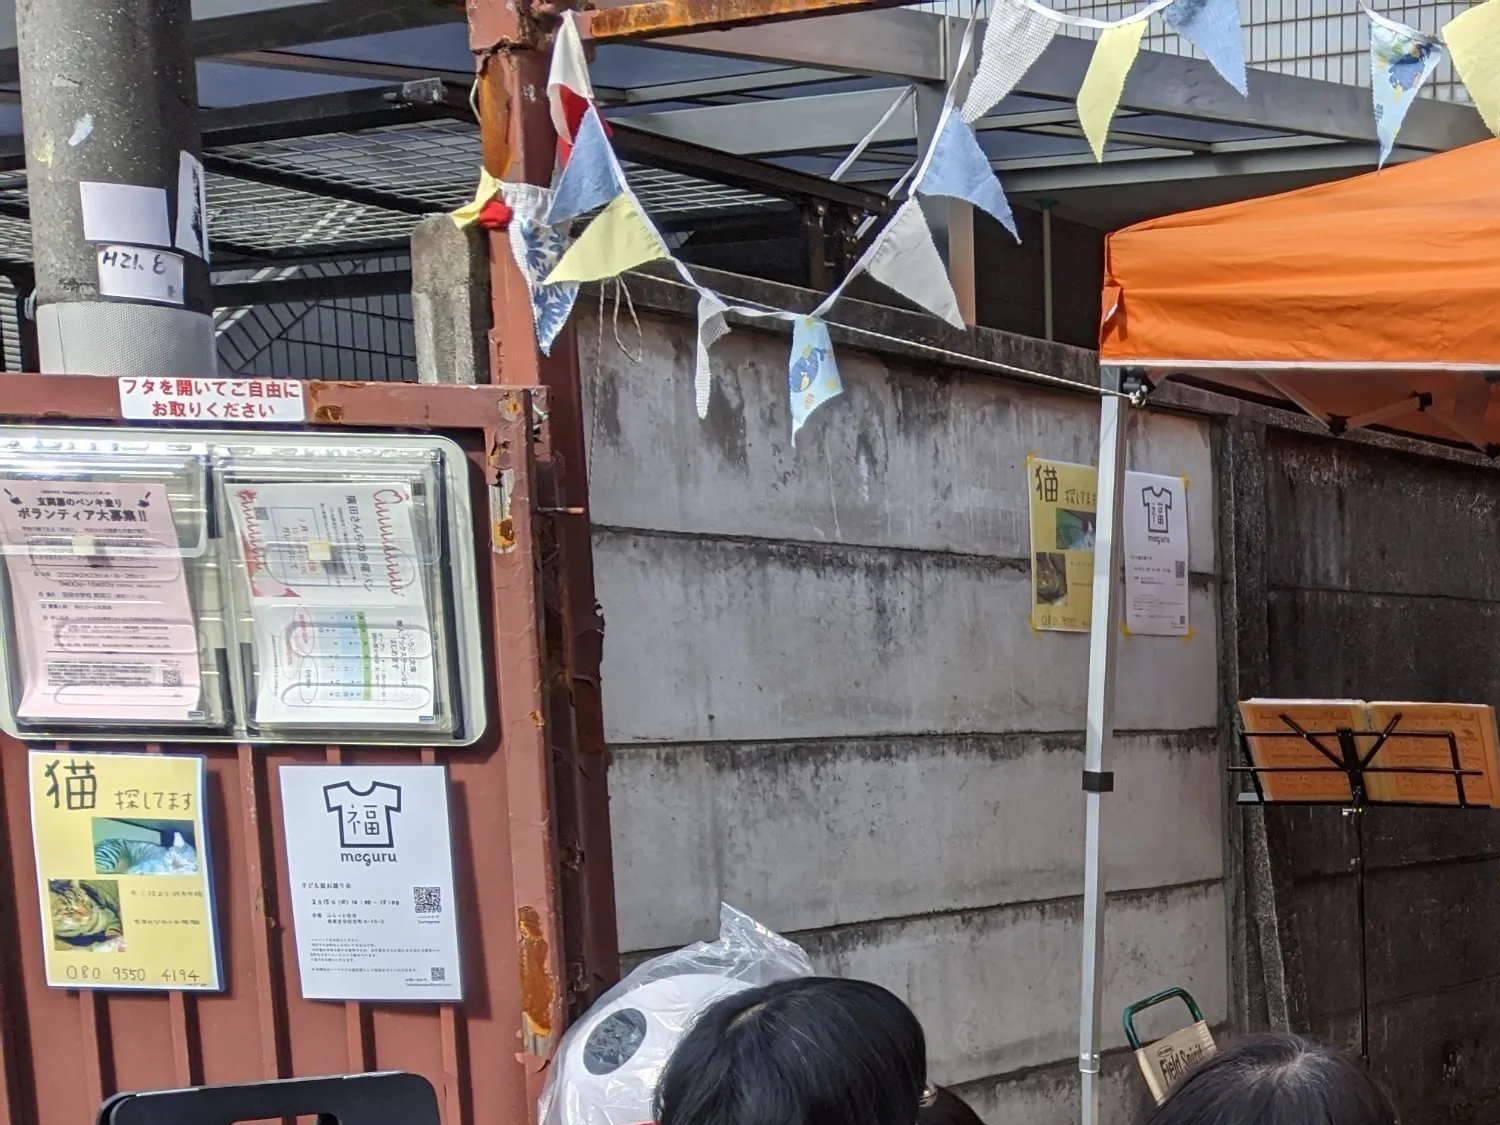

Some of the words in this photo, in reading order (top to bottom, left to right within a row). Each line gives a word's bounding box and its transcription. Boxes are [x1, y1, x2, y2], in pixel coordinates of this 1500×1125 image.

[122, 379, 300, 398] フタを開いてご自由に
[152, 400, 275, 418] お取りください
[1035, 464, 1058, 502] 猫
[44, 758, 97, 811] 猫
[114, 789, 193, 811] 探してます
[346, 803, 381, 836] 福
[341, 850, 398, 867] meguru
[66, 965, 101, 980] 080
[112, 967, 146, 982] 9550
[161, 968, 201, 982] 4194
[1158, 1052, 1181, 1089] Field
